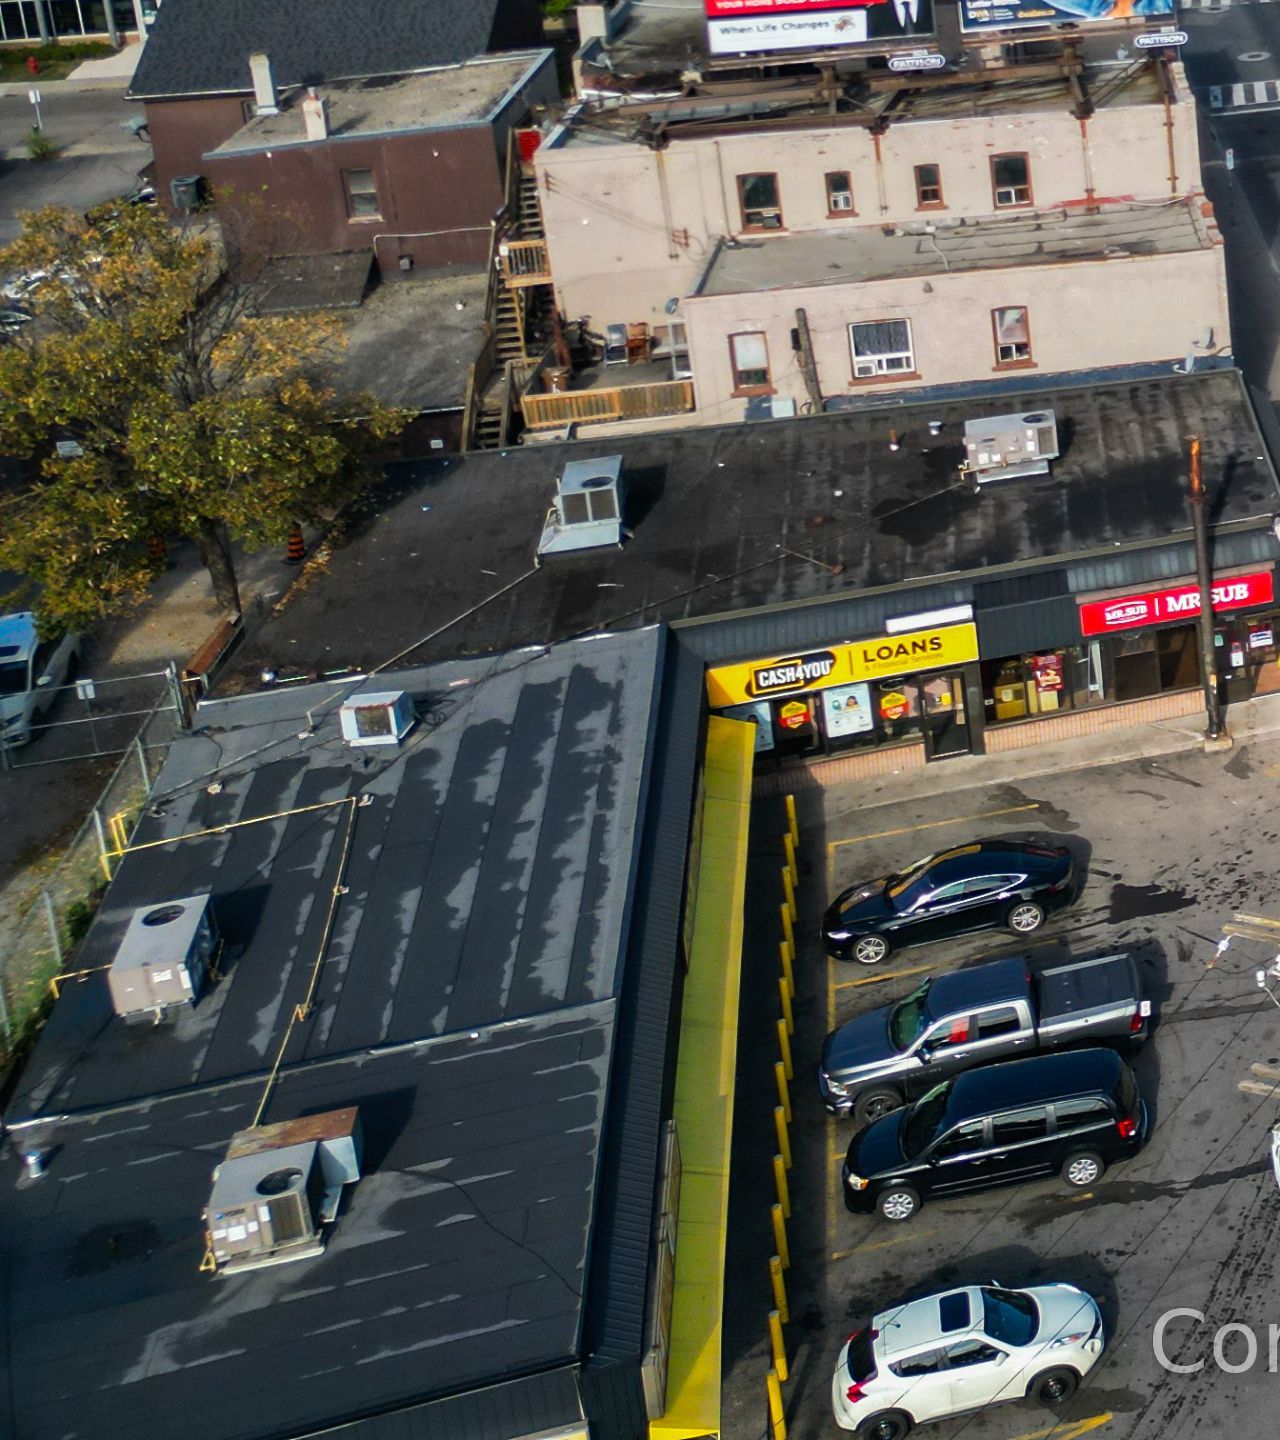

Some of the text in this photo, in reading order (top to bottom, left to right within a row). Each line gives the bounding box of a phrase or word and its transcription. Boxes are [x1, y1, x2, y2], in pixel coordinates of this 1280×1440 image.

[719, 19, 830, 36] When Life Changes
[1138, 35, 1184, 46] PATTISON
[893, 58, 941, 70] PATTISON
[863, 636, 943, 663] LOANS
[758, 660, 833, 687] CASH4YOU
